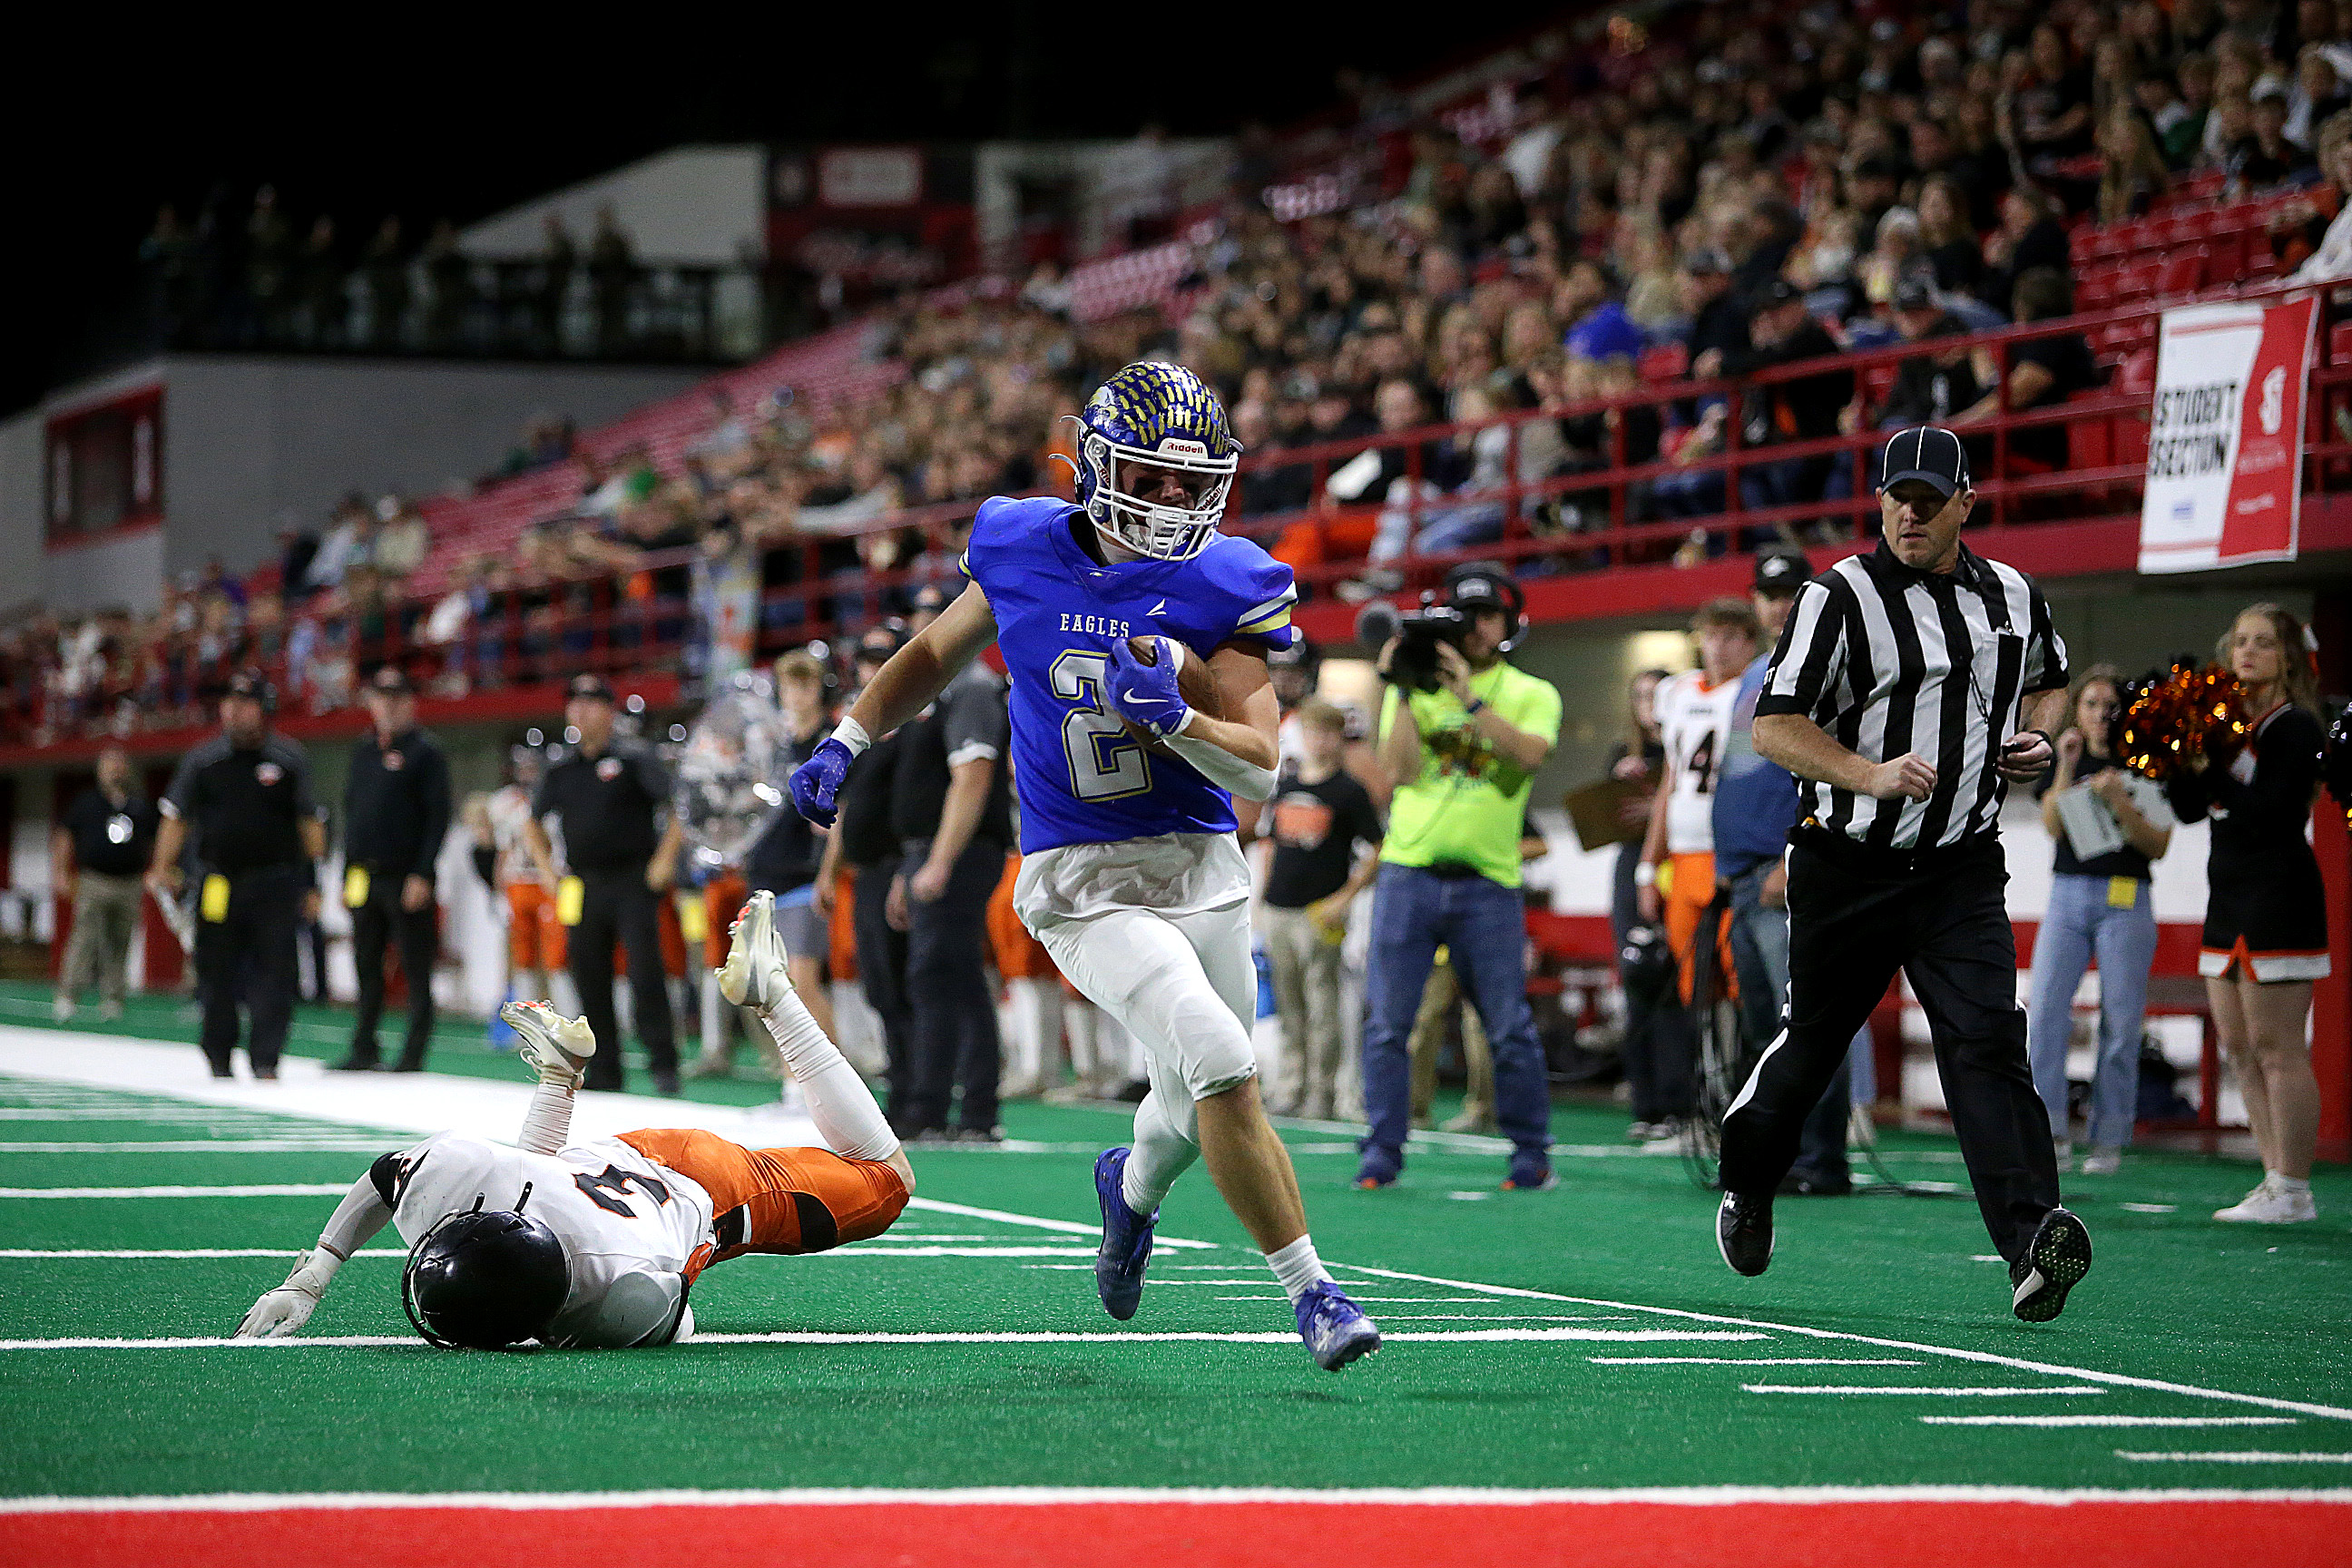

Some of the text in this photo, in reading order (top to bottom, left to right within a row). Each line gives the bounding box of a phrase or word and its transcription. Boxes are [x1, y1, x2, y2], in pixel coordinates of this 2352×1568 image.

[2154, 381, 2237, 427] STUDENT
[1167, 442, 1203, 454] Riddell
[2146, 433, 2230, 477] SECTION
[1059, 612, 1130, 638] EAGLES
[1048, 649, 1153, 804] 2
[570, 1163, 671, 1220] 3
